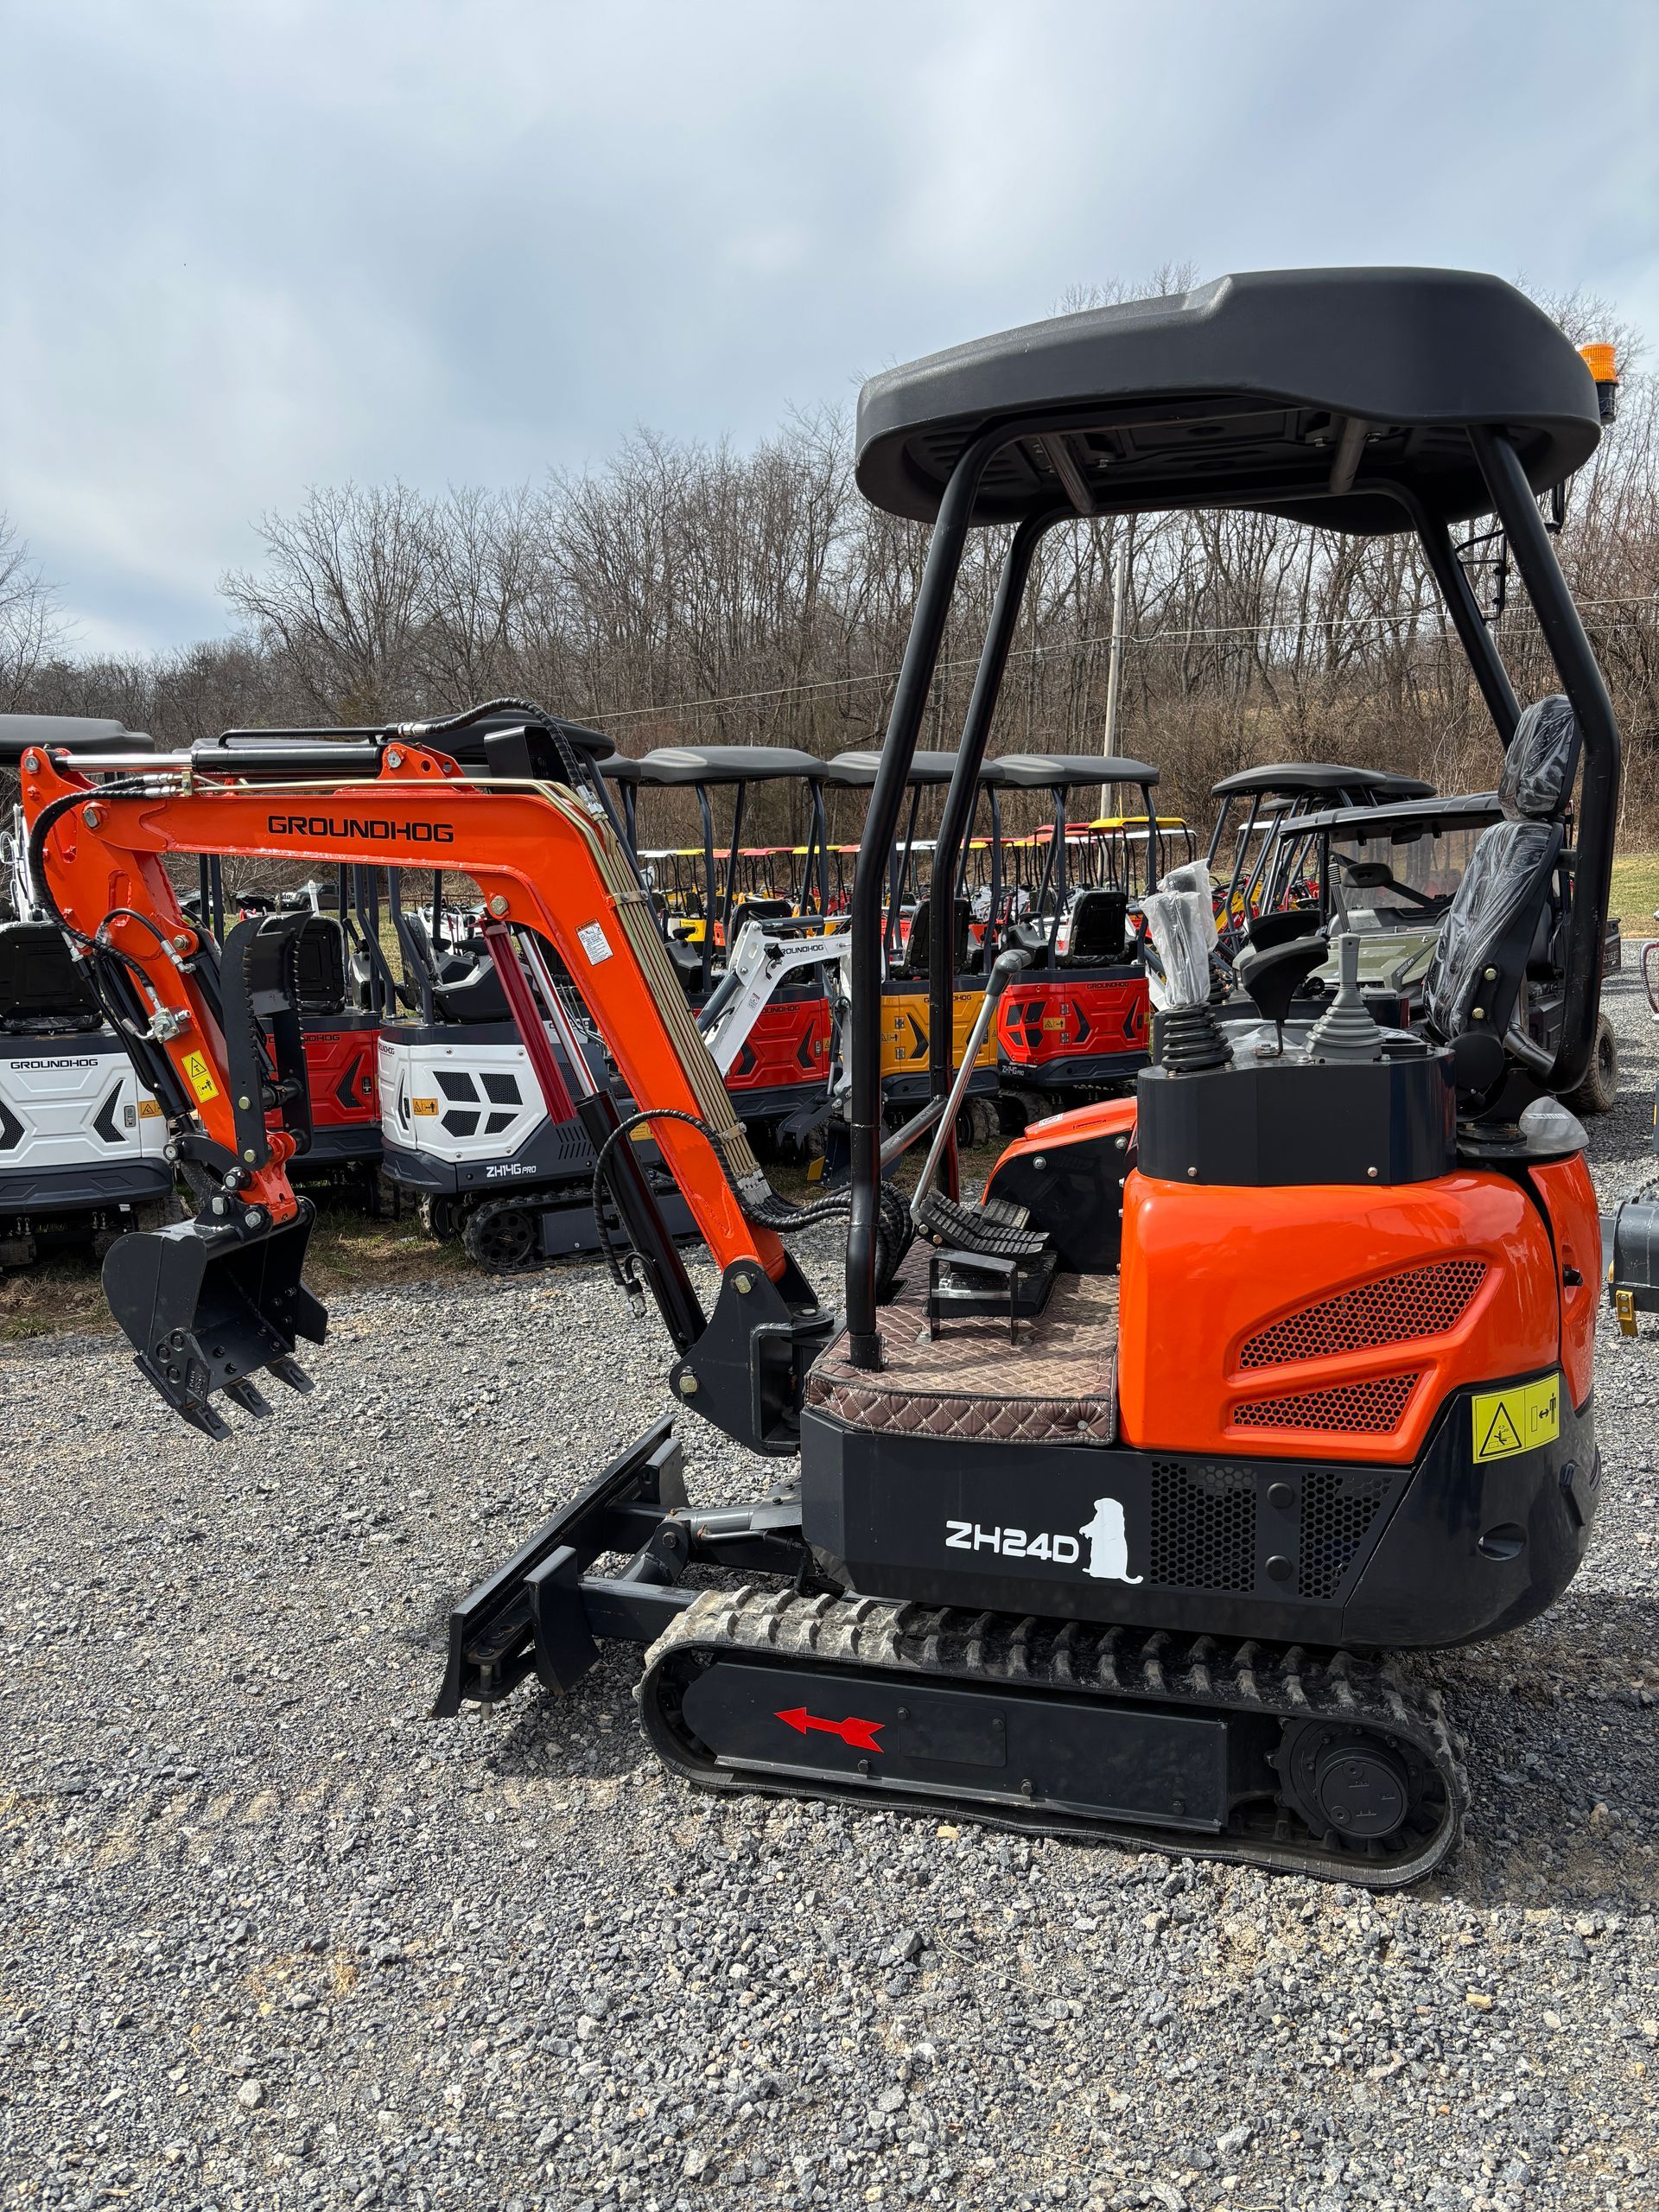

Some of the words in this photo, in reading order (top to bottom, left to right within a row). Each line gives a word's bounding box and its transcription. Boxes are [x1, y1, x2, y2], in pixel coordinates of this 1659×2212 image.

[268, 815, 454, 842] GROUNDHOG
[781, 944, 824, 955] ROUNDHOG
[10, 1059, 99, 1069] GROUNDHOG
[486, 1164, 521, 1178] ZH14G
[522, 1166, 537, 1174] PRO
[945, 1520, 1079, 1564] ZH24D
